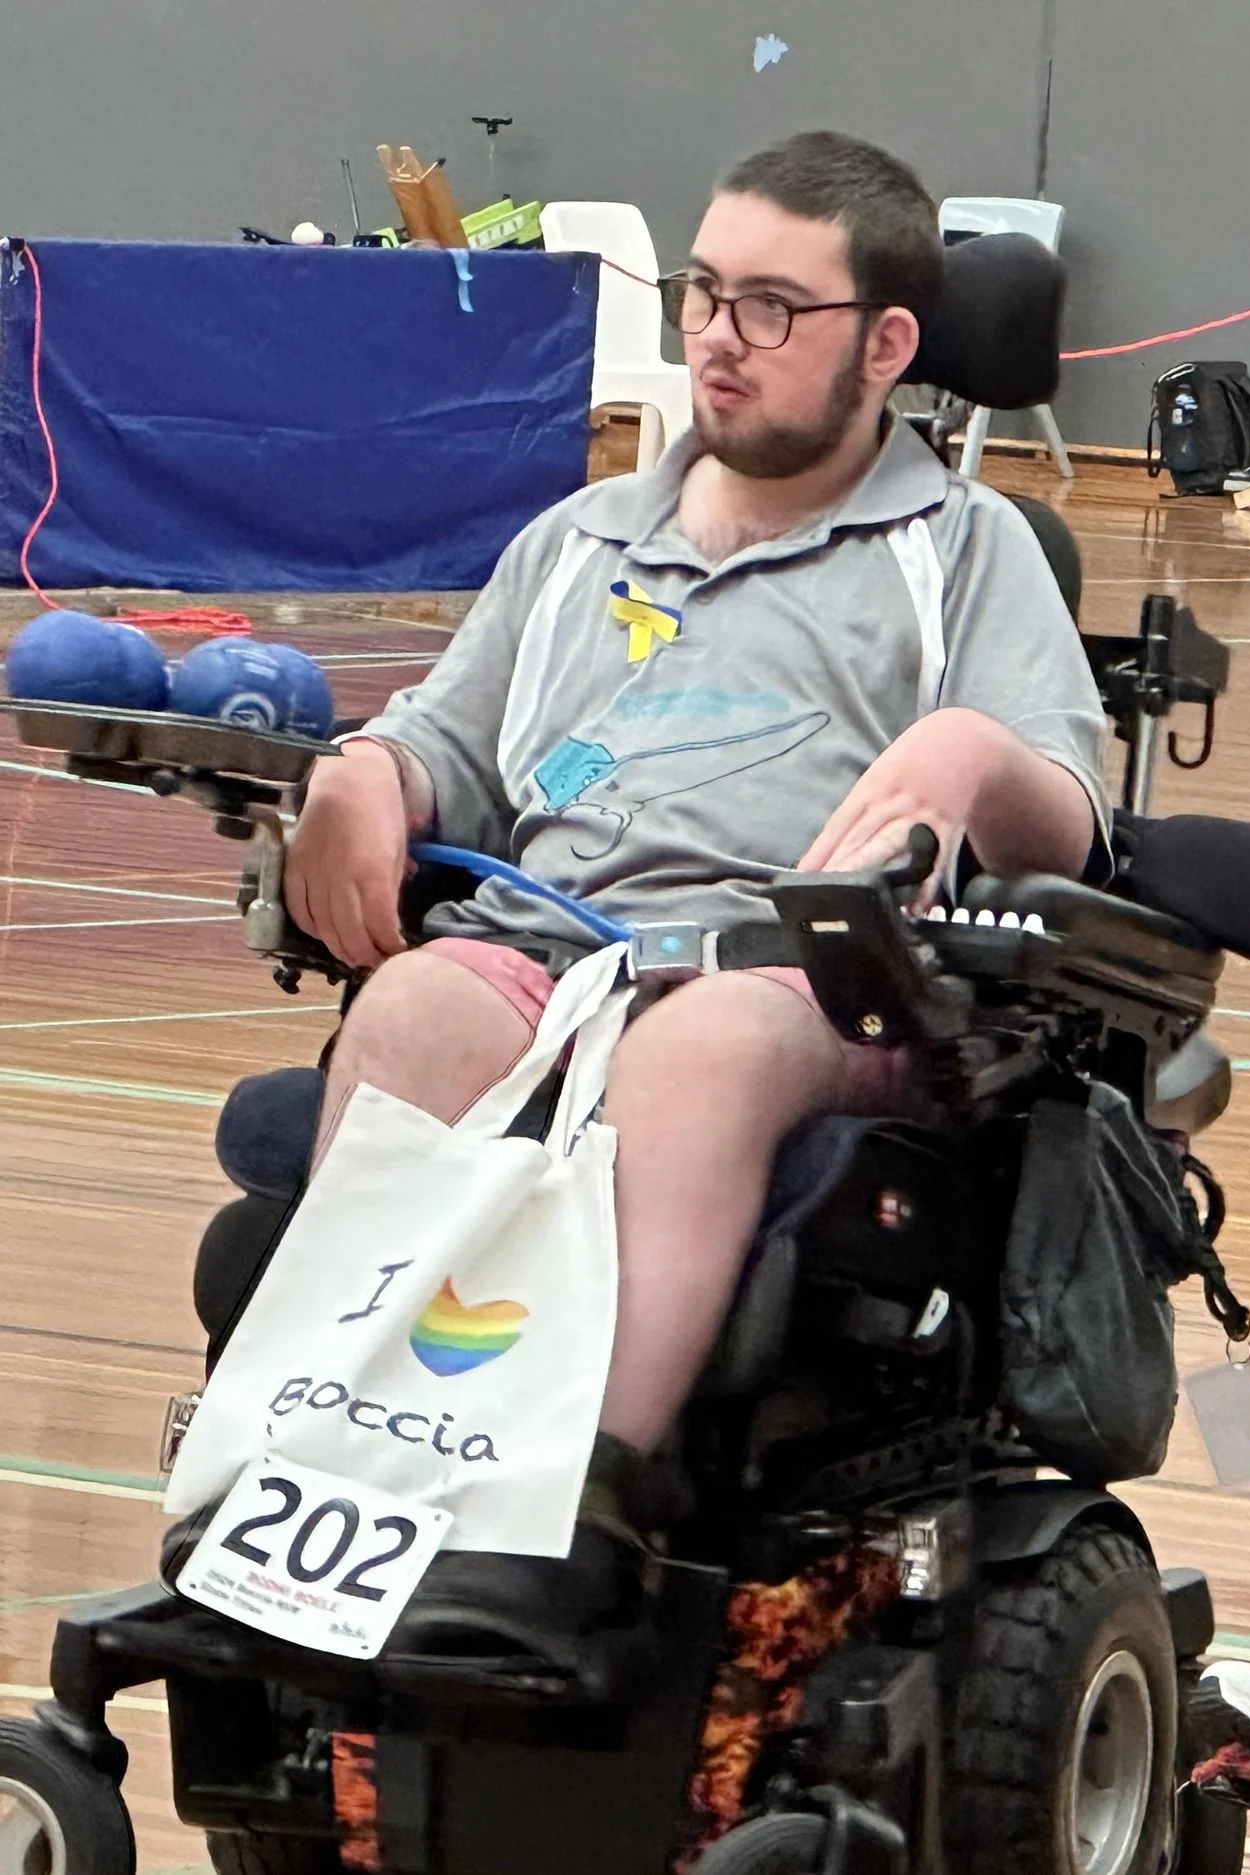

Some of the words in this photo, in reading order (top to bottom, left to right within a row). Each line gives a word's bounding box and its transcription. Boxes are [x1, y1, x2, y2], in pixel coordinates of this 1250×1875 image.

[338, 1259, 414, 1323] I
[269, 1377, 499, 1462] Boccia
[220, 1477, 417, 1602] 202
